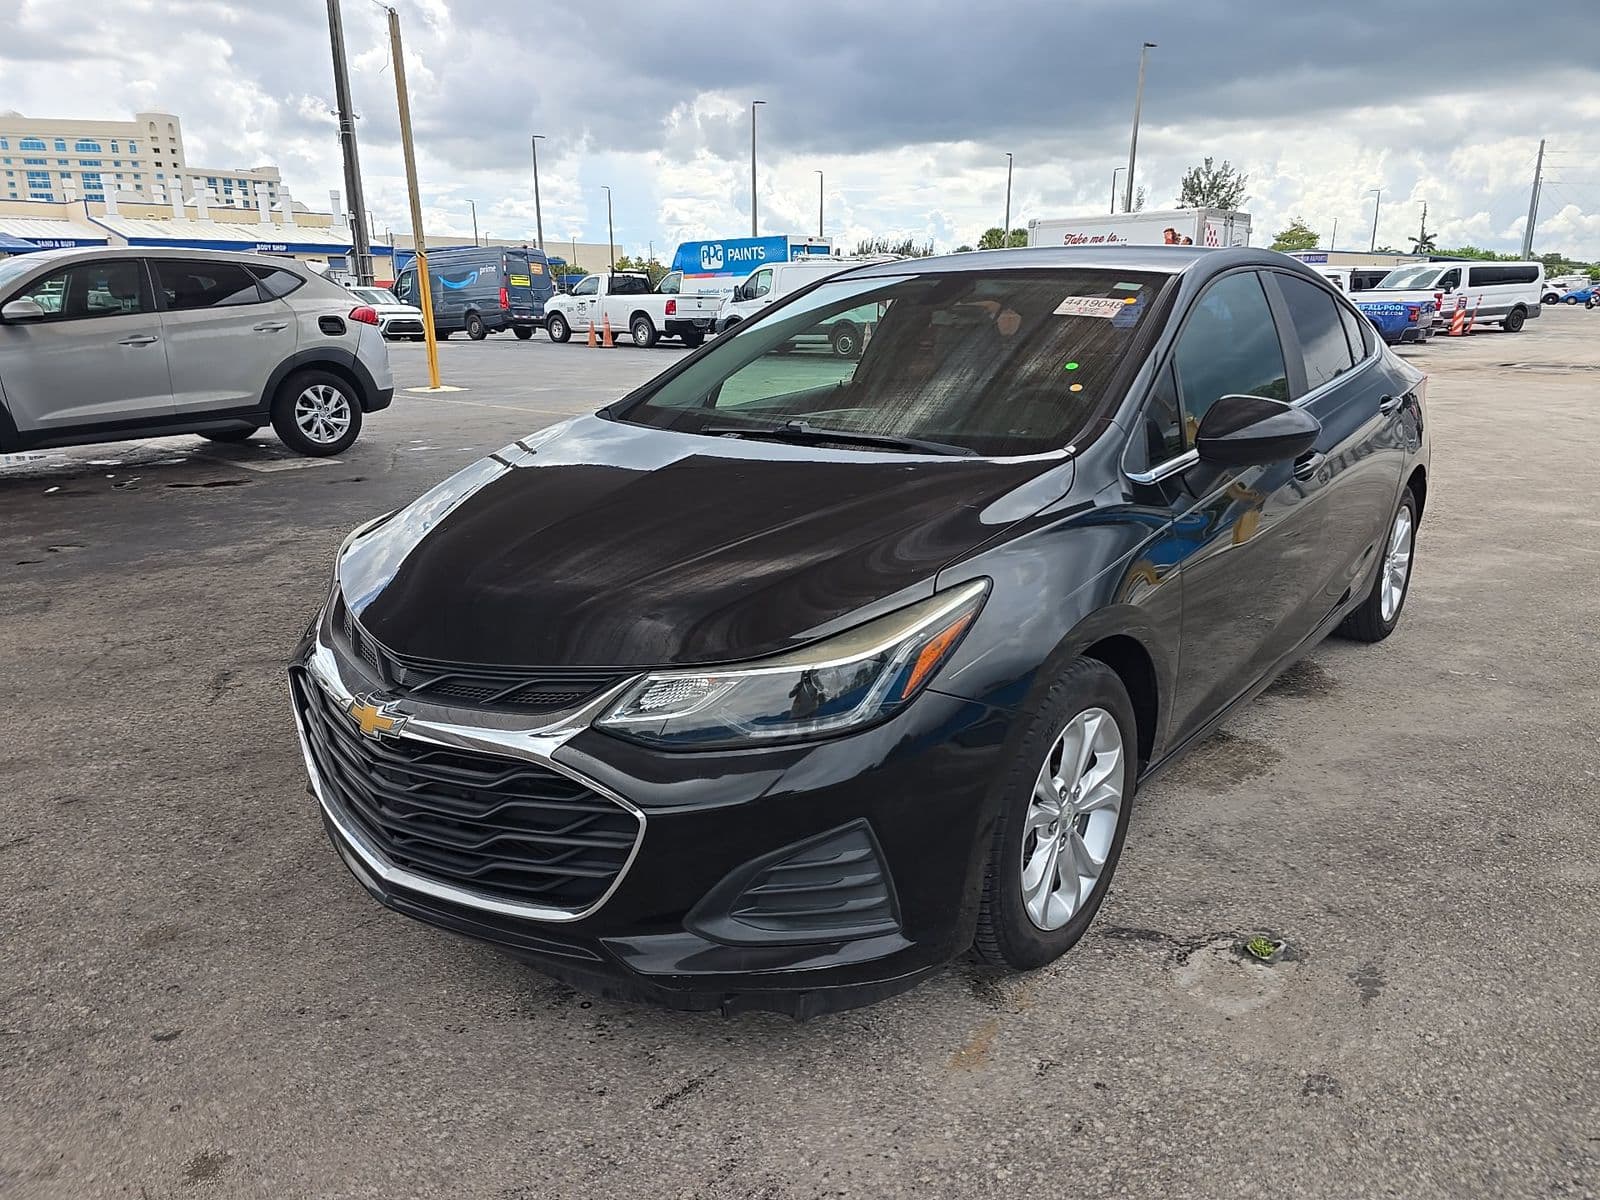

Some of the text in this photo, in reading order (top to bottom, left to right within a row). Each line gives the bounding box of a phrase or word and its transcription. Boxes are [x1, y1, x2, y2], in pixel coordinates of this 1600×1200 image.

[36, 240, 53, 248] SAND
[1064, 233, 1088, 245] Take
[1089, 235, 1104, 243] me
[256, 243, 287, 252] BODY SHOP
[702, 245, 722, 265] PPG
[727, 247, 766, 261] PAINTS
[480, 265, 496, 275] prime
